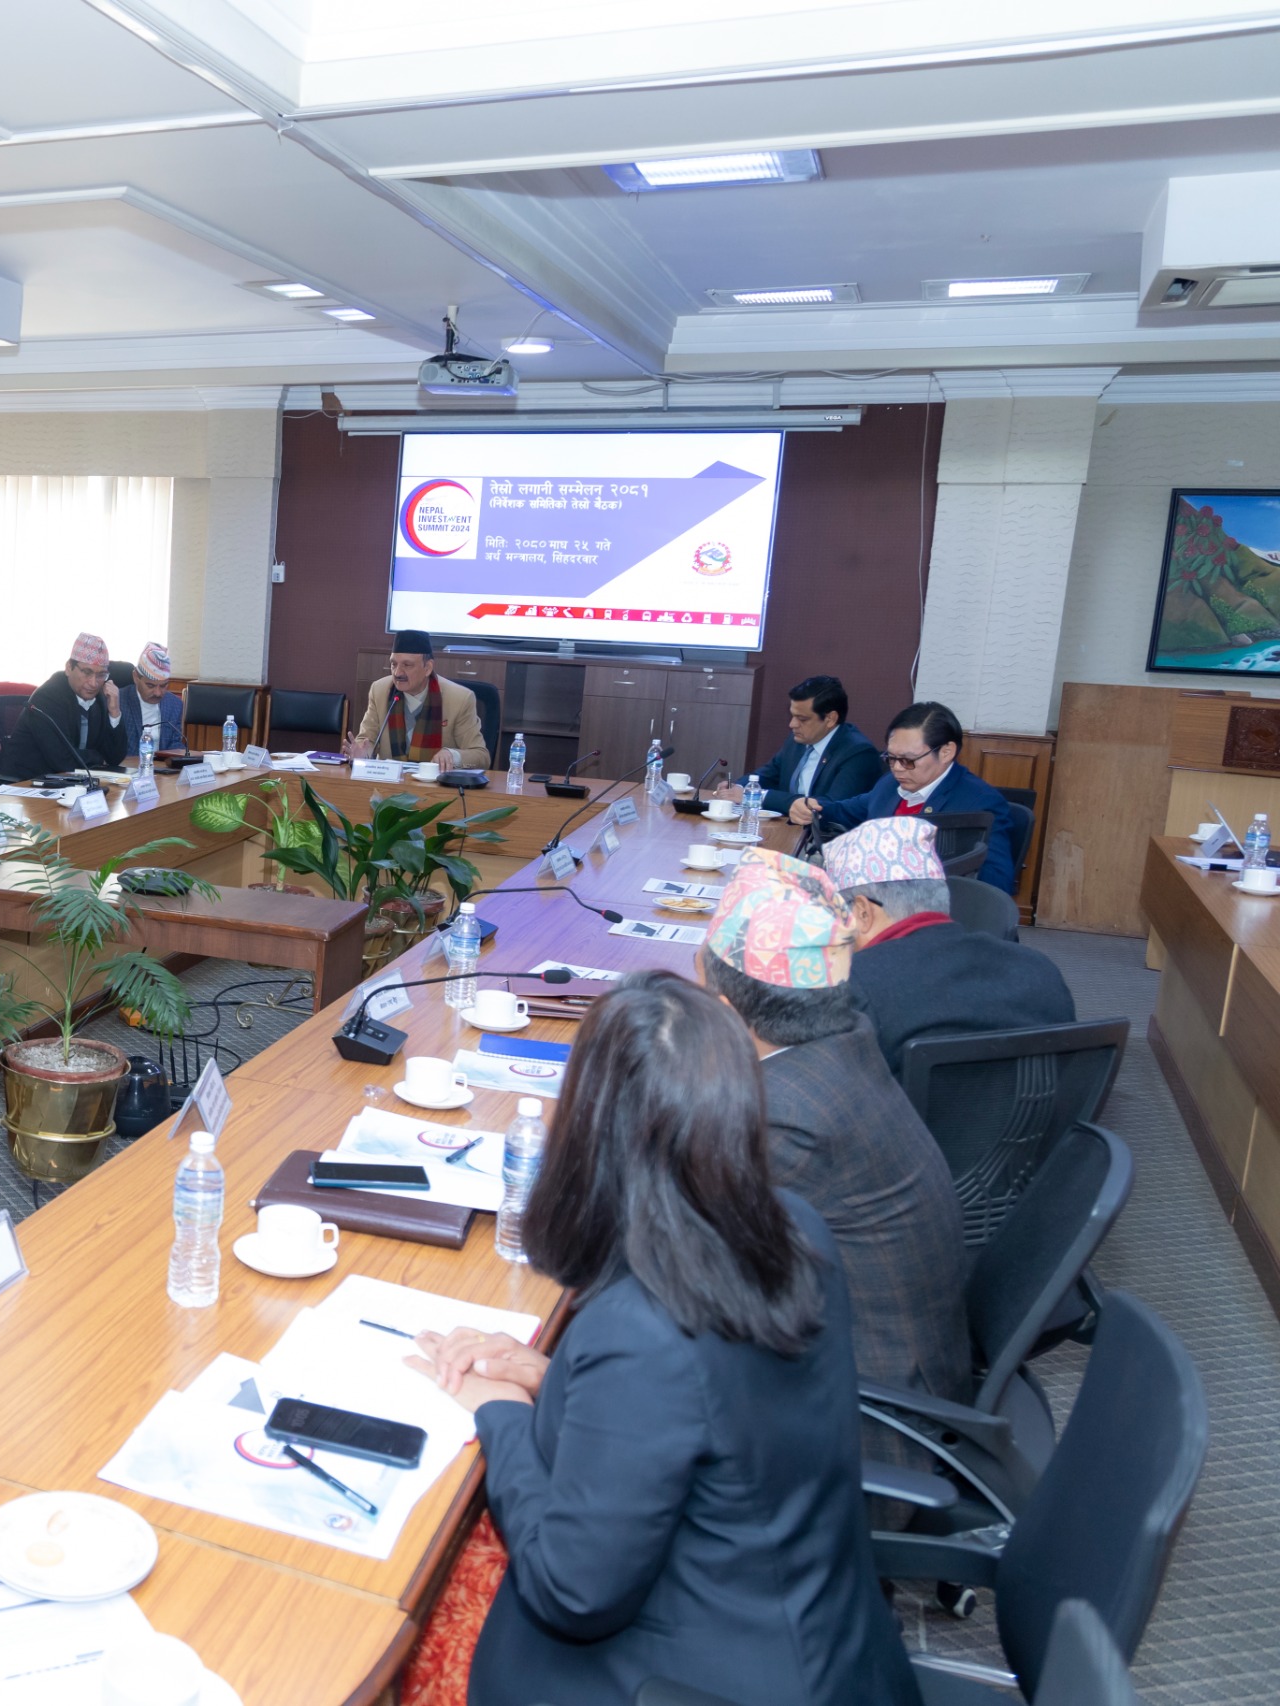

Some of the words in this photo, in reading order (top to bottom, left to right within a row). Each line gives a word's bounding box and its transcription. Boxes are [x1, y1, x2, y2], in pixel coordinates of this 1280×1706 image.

[518, 480, 553, 495] लगानी
[558, 480, 604, 496] सम्मेलन
[610, 483, 648, 498] २०८१
[419, 506, 444, 514] NEPAL
[418, 524, 449, 532] SUMMIT
[515, 539, 547, 549] २०८०
[549, 540, 568, 550] माघ
[595, 538, 612, 551] गते
[485, 549, 501, 562] अर्थ
